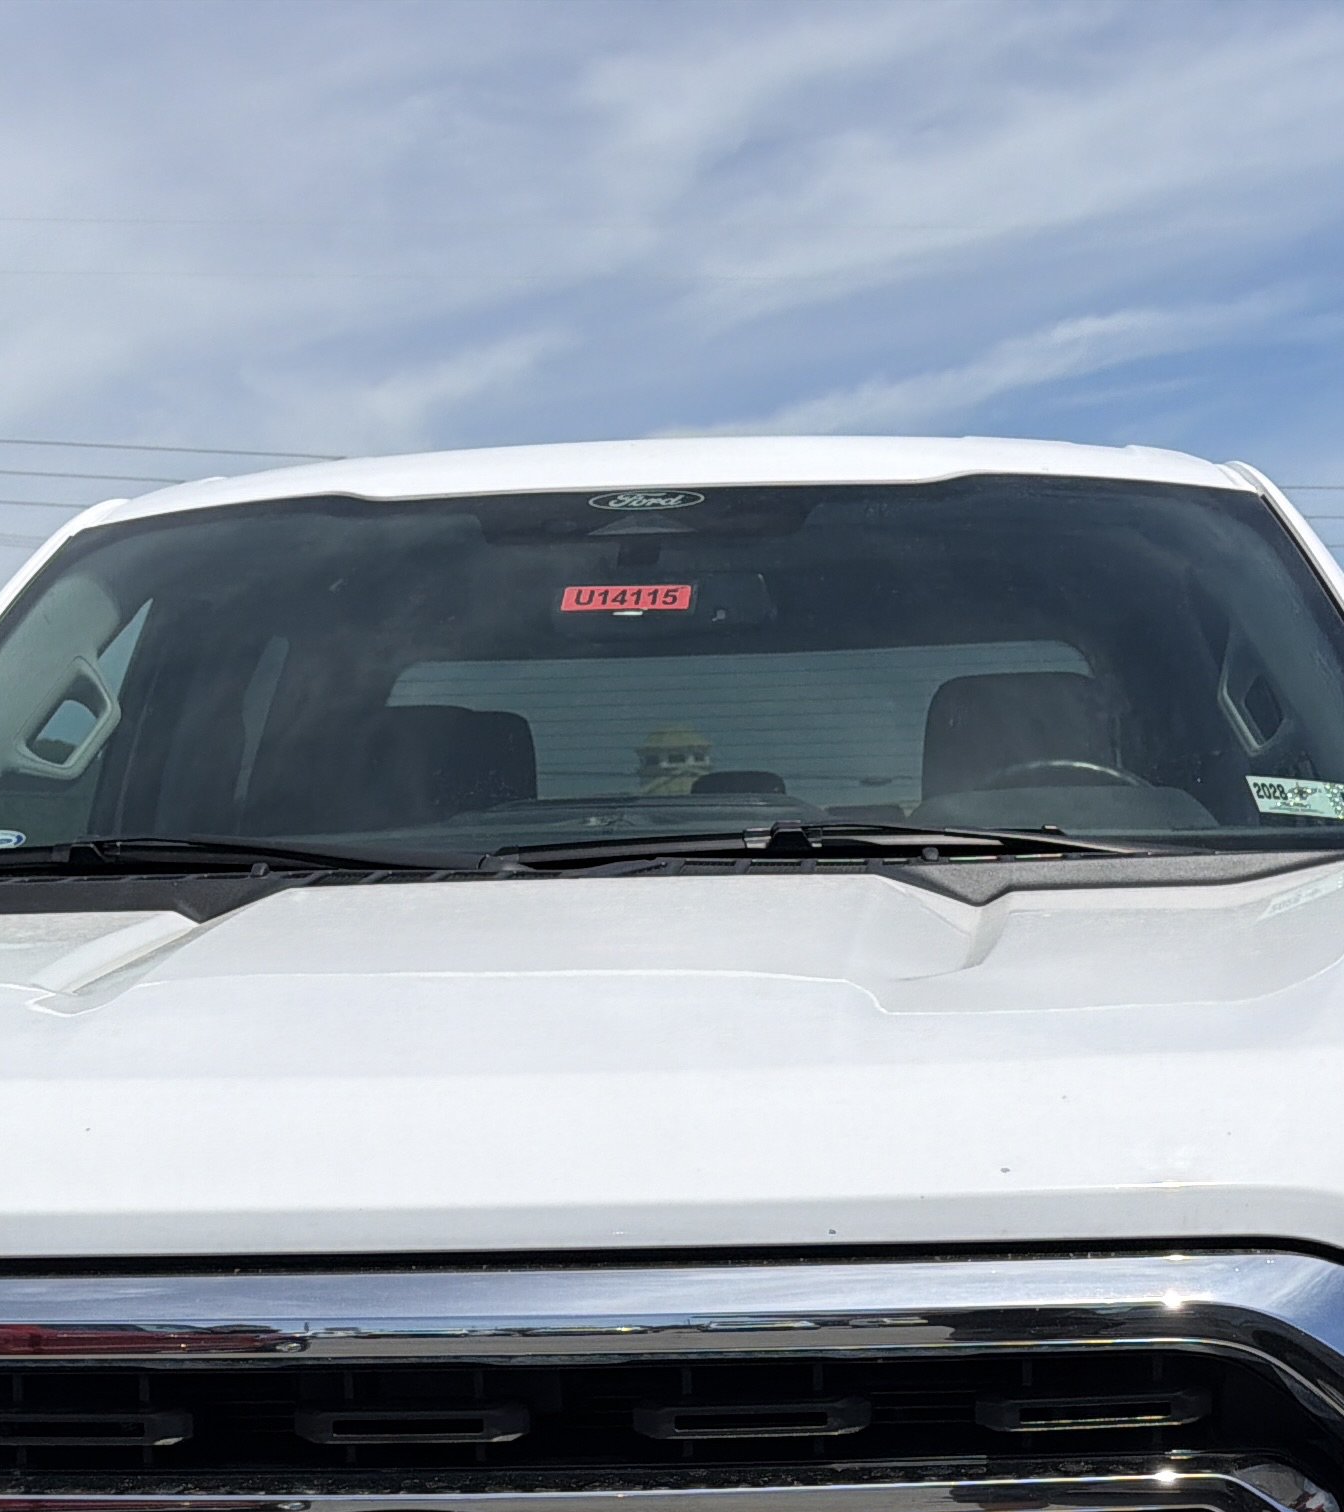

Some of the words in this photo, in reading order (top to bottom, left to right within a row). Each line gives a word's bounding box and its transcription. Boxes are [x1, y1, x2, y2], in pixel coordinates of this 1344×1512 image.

[609, 491, 684, 508] Ford
[575, 588, 679, 606] U14115
[1253, 781, 1289, 801] 2028
